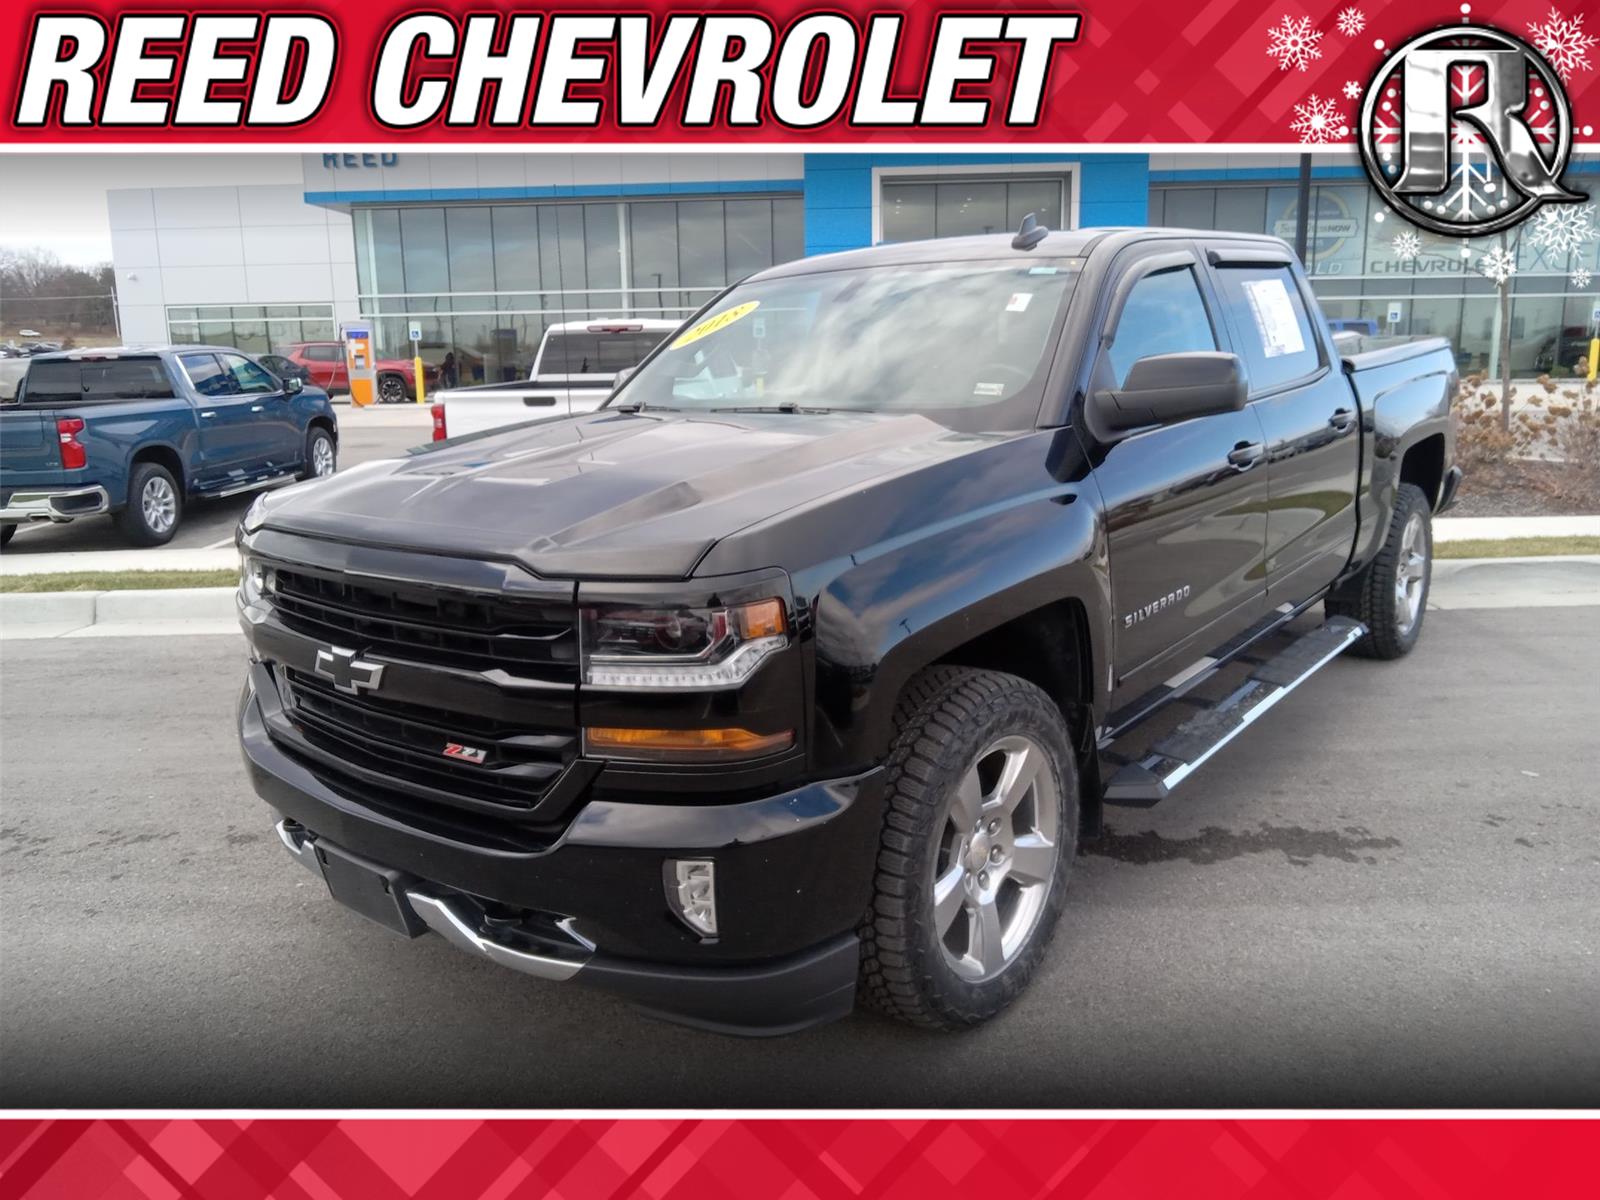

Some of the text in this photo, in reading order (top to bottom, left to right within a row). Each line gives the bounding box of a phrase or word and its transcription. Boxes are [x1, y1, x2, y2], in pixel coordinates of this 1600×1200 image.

[322, 153, 399, 168] REED
[1370, 259, 1487, 273] CHEVROLE
[1124, 584, 1191, 629] SILVERADO
